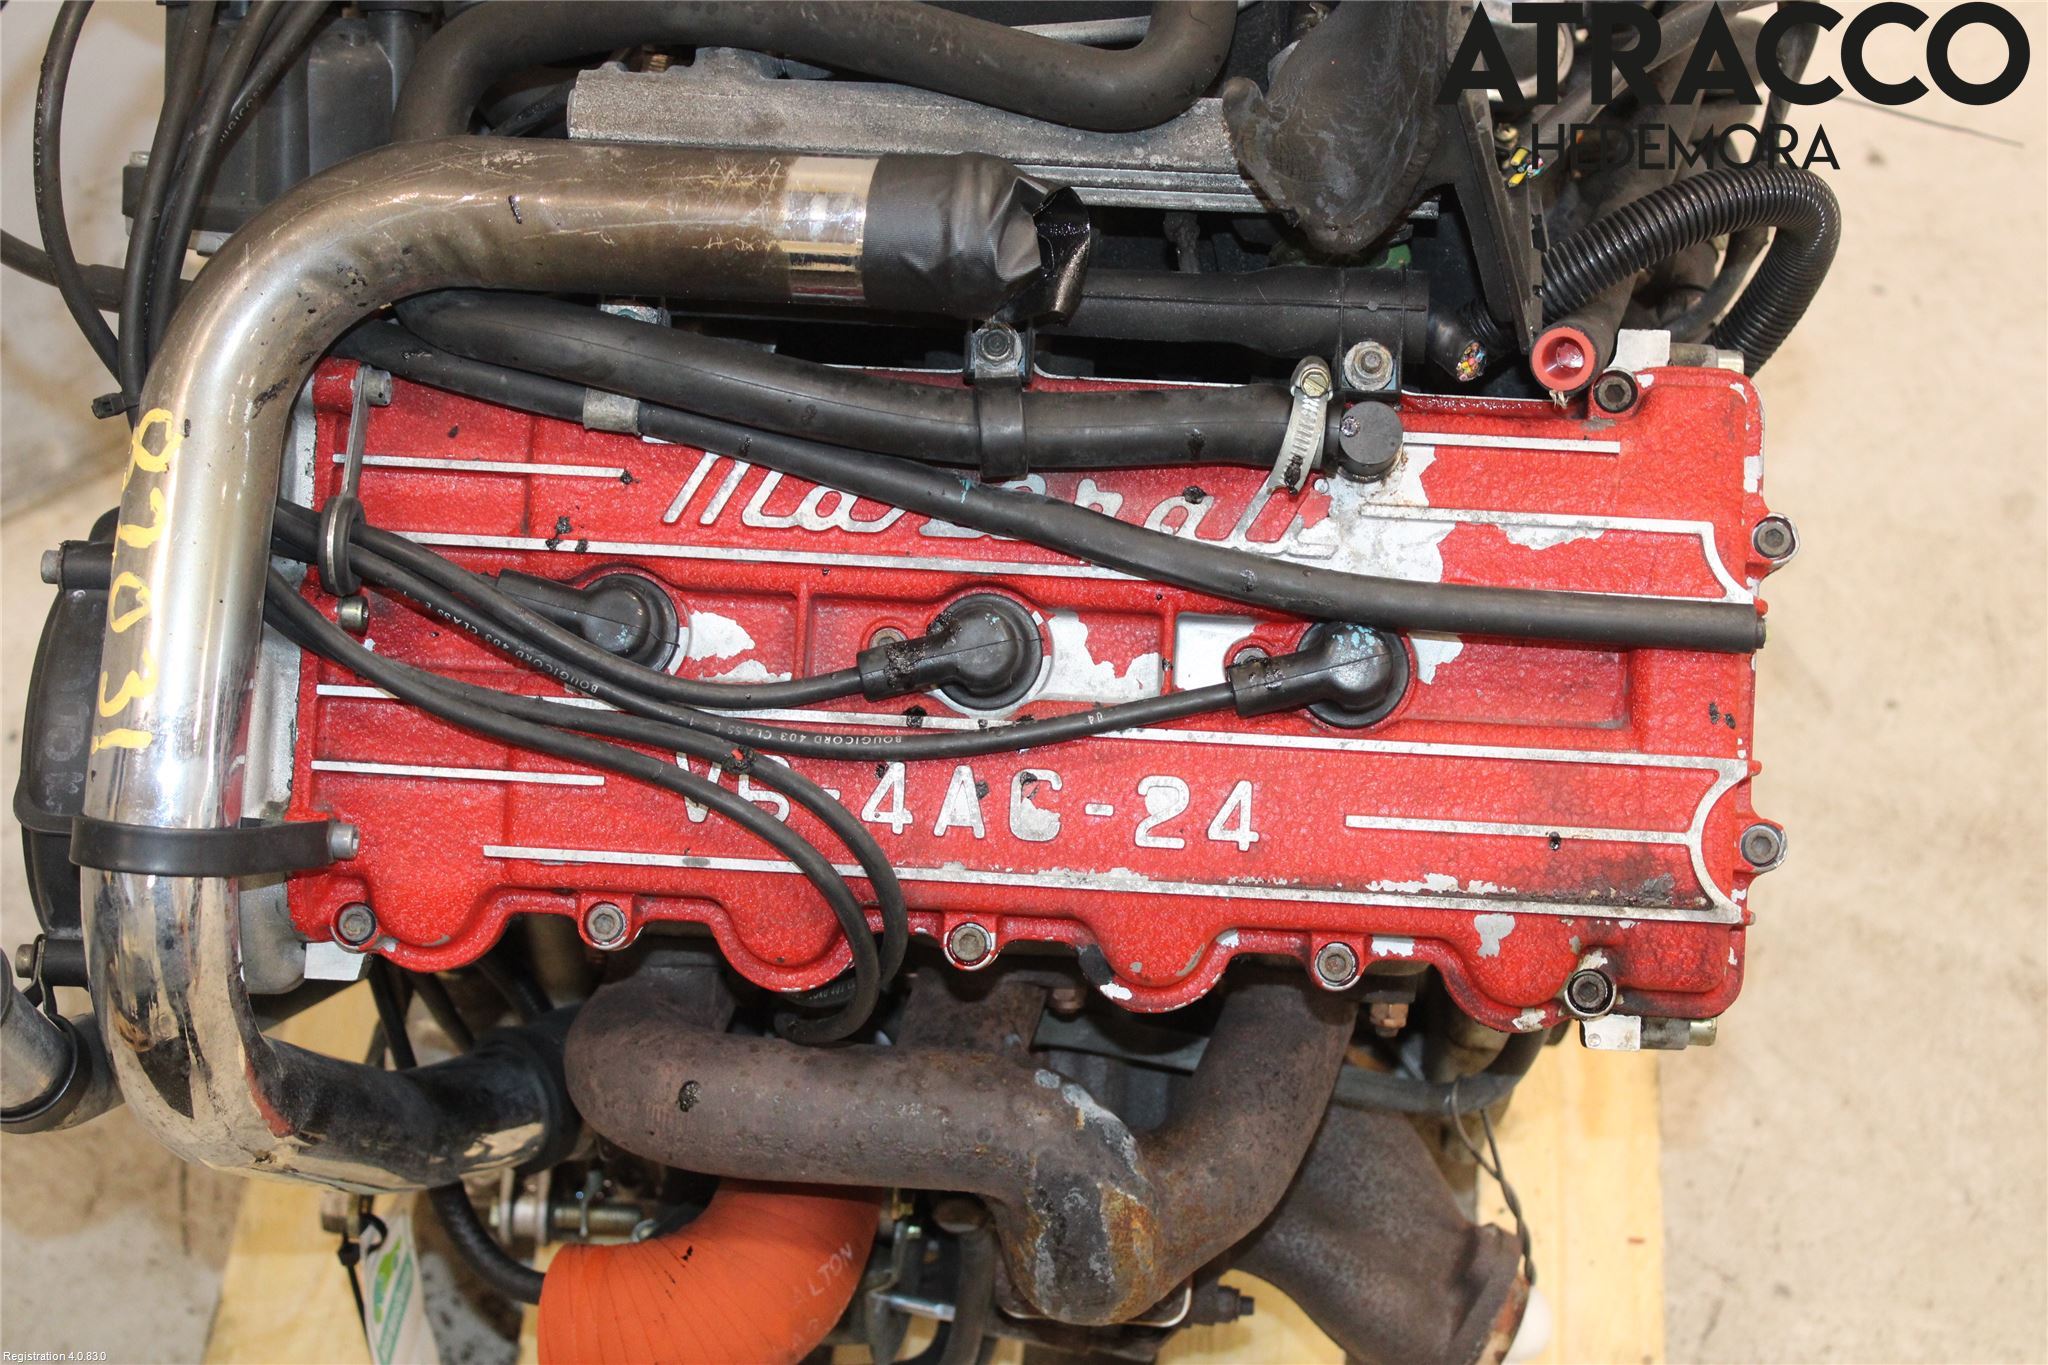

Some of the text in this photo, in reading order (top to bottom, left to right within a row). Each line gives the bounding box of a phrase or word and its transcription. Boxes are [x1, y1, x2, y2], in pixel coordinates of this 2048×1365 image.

[515, 648, 600, 694] BOUGICORD
[727, 725, 772, 741] CLASS
[779, 732, 806, 743] 403
[814, 735, 902, 745] BOUGICORD
